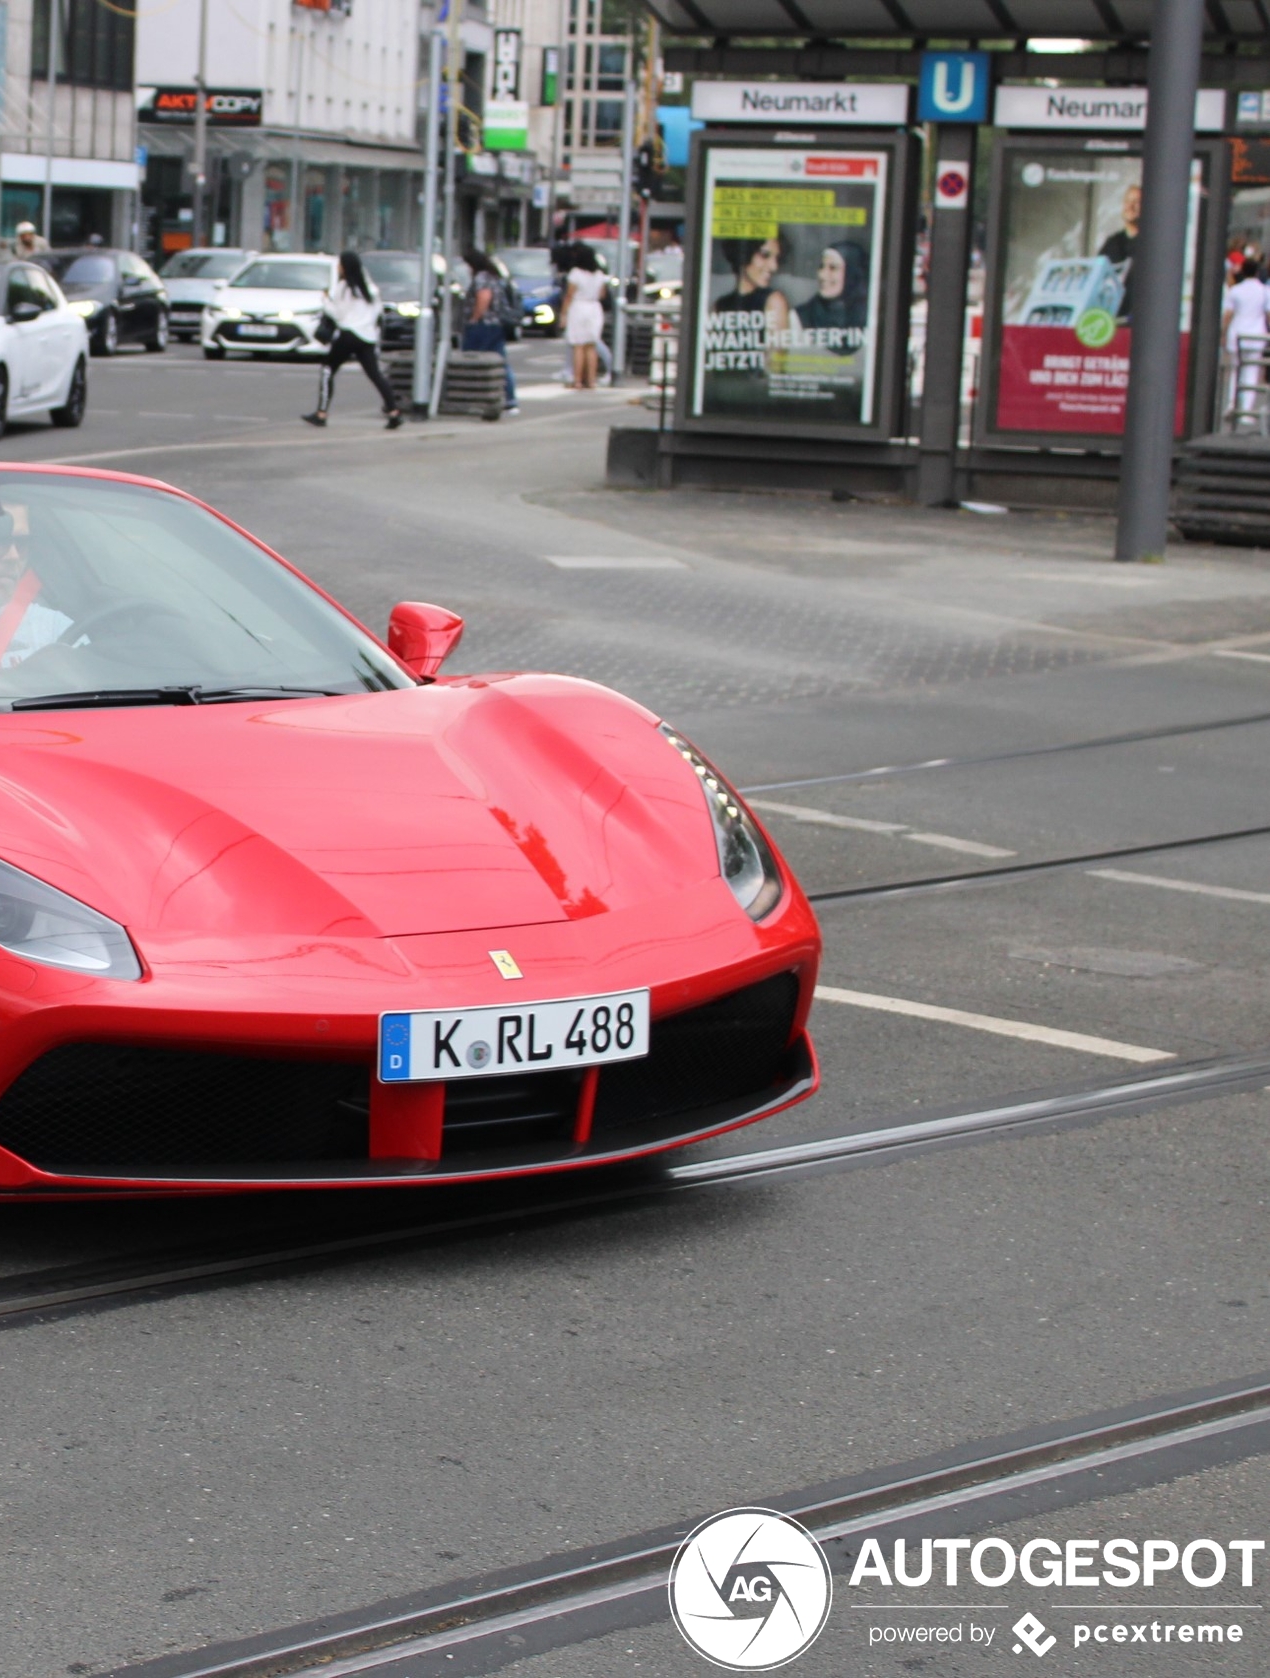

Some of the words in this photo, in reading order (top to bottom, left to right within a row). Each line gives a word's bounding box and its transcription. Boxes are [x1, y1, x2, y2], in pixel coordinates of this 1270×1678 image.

[933, 61, 975, 114] U
[741, 89, 858, 112] Neumarkt
[1047, 95, 1144, 118] Neumar
[705, 310, 777, 330] WERDE
[704, 351, 764, 370] JETZT!
[390, 1054, 403, 1069] D
[434, 1018, 463, 1069] K
[497, 1013, 553, 1064] RL
[564, 1002, 635, 1057] 488
